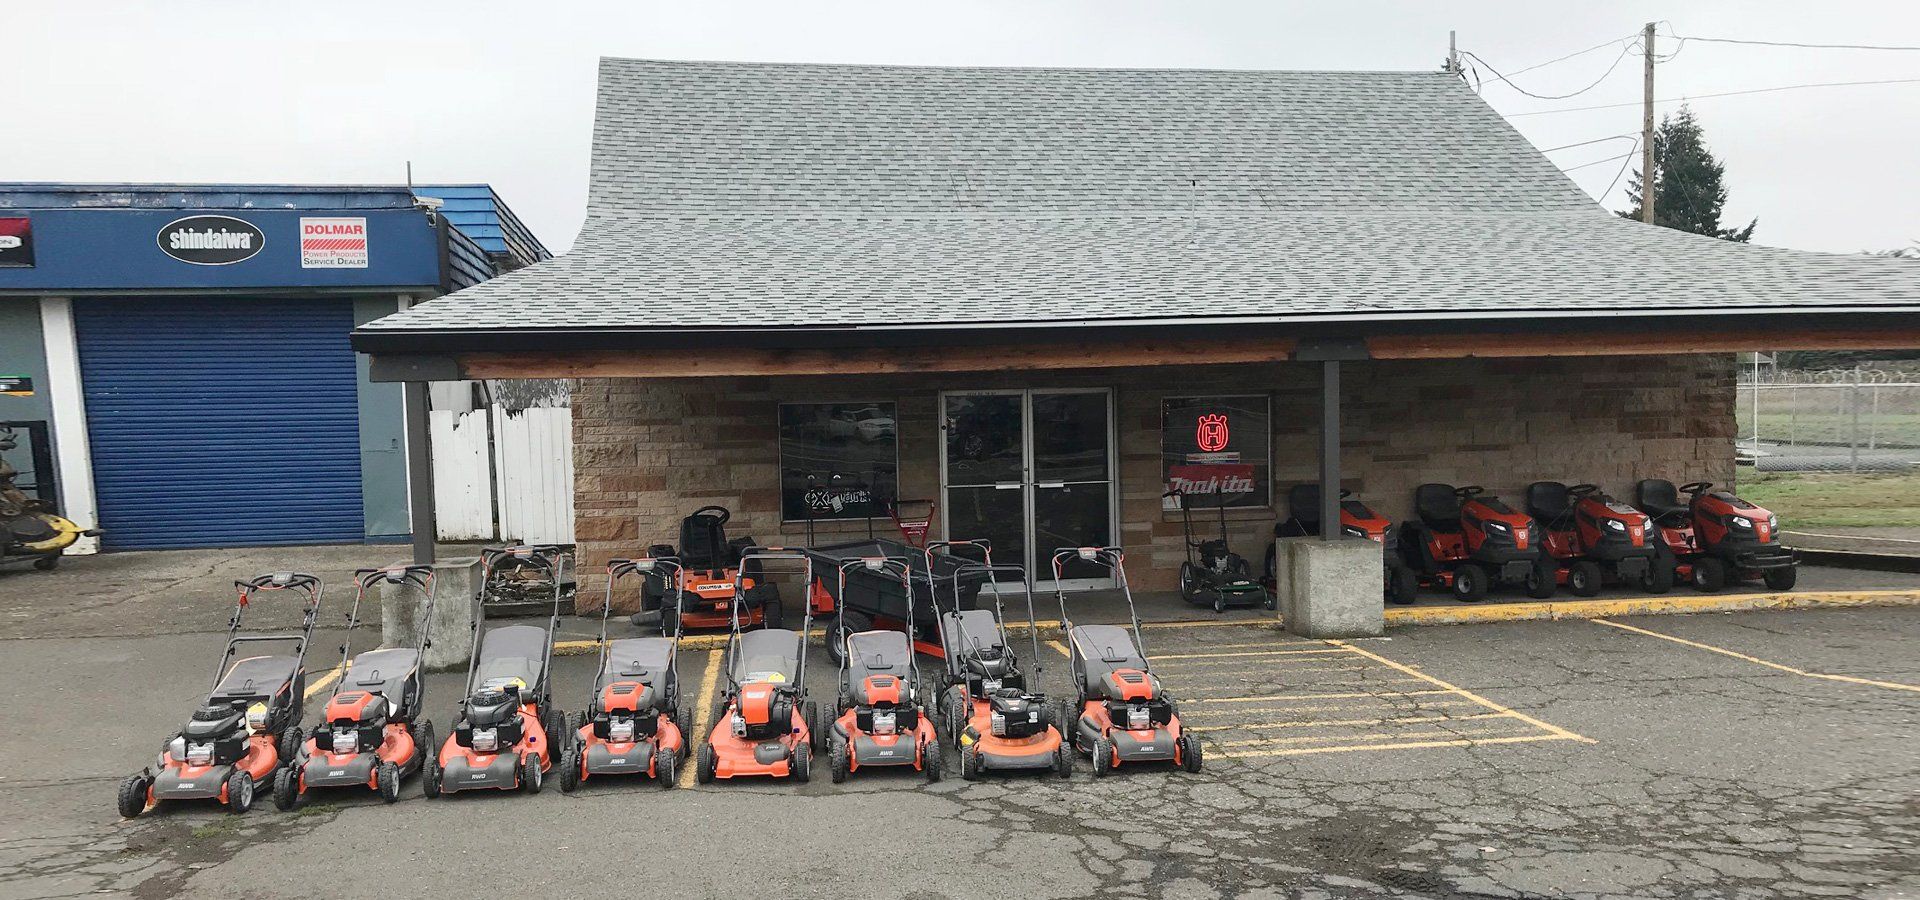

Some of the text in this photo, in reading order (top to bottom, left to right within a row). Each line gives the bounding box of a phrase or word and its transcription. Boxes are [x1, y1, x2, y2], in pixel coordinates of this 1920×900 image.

[305, 225, 363, 235] DOLMAR
[169, 228, 251, 249] shindaiwa
[303, 257, 366, 265] SERVICE DEALER
[328, 769, 345, 777] AWD
